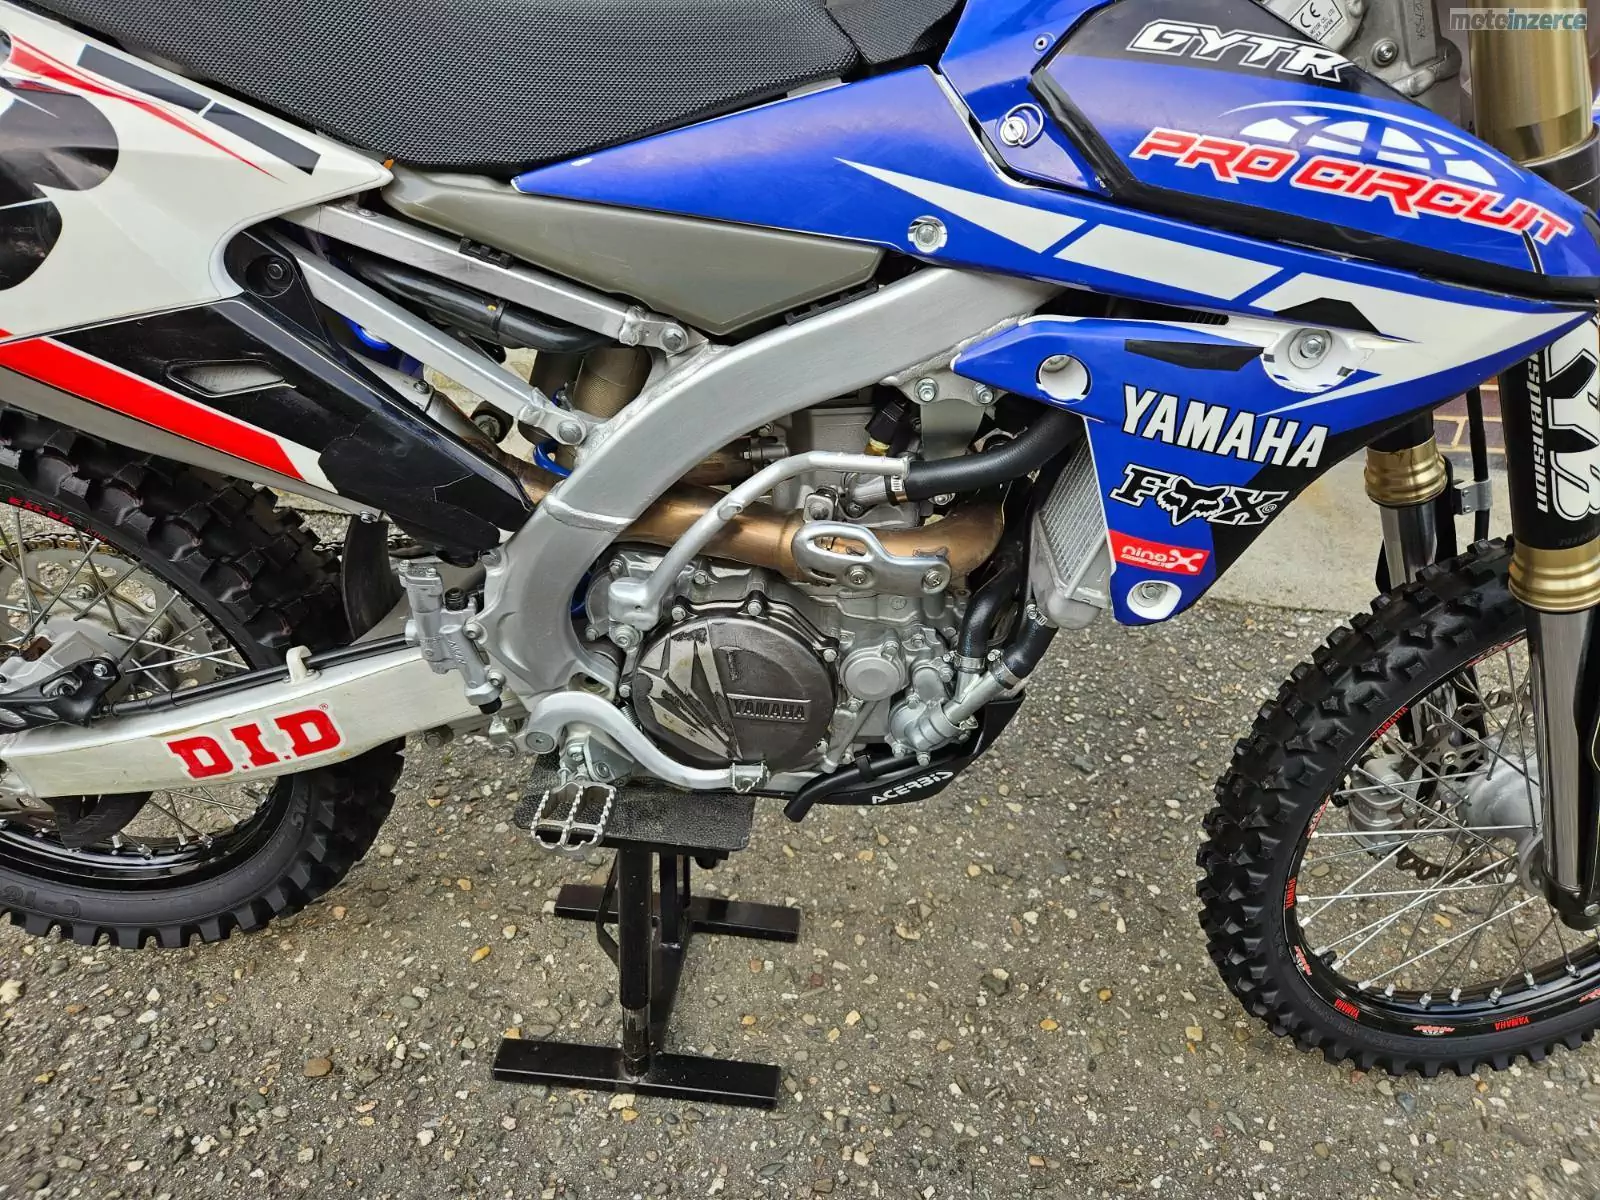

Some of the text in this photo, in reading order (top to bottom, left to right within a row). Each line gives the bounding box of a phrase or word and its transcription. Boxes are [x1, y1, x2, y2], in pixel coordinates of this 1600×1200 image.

[1126, 18, 1356, 82] GYTR
[1130, 126, 1575, 246] PRO CIRCUIT
[1122, 384, 1329, 468] YAMAHA
[1526, 348, 1549, 514] spension
[734, 699, 806, 721] YAMAHA
[1371, 706, 1409, 740] YAMAHA
[1494, 1016, 1530, 1032] YAMAHA
